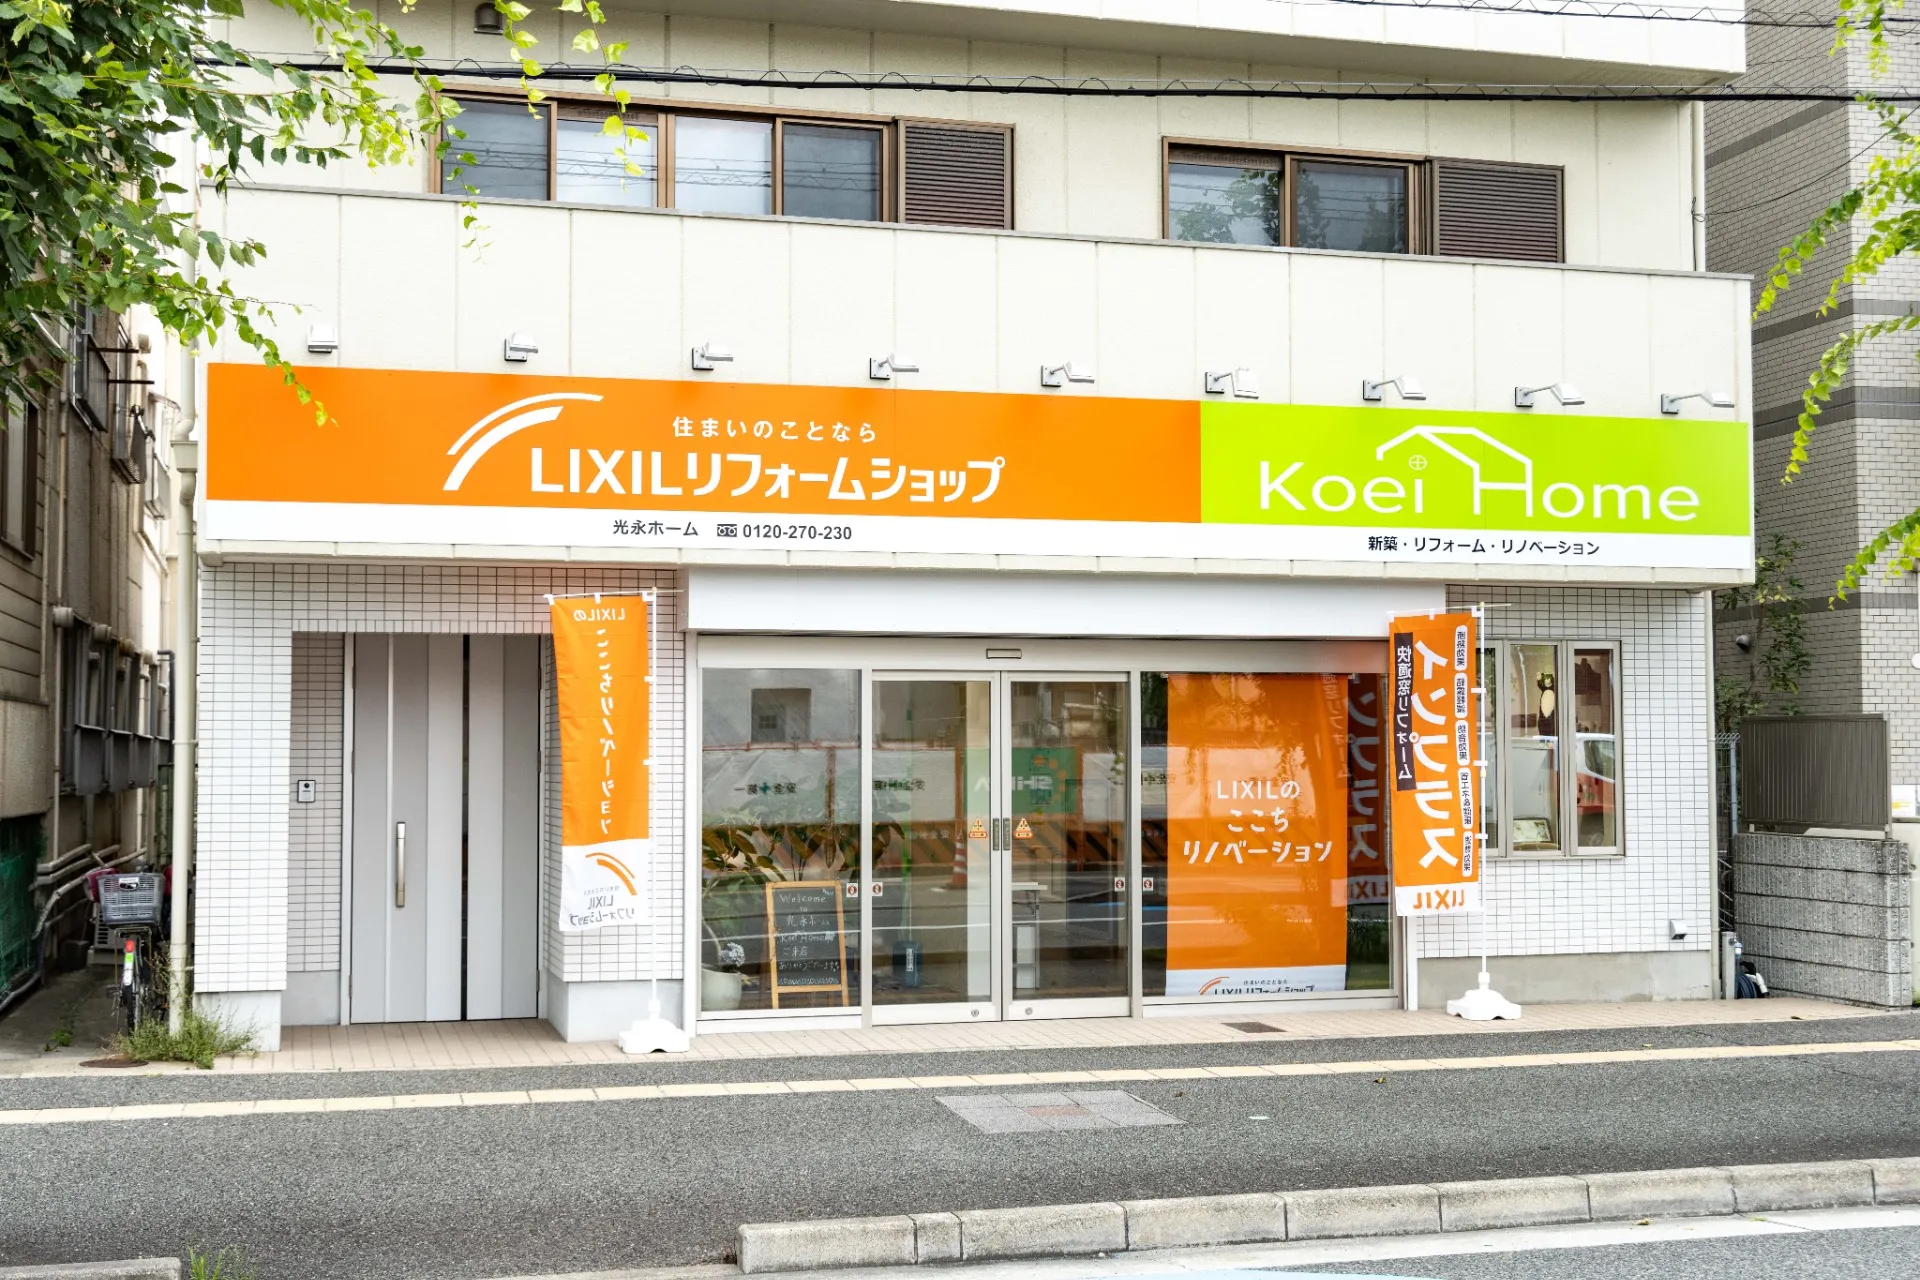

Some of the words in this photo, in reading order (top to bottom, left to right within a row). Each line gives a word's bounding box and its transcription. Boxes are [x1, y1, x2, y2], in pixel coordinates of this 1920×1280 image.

[672, 416, 878, 443] 住まいのことなら
[530, 446, 1006, 504] LIXILリフォームショップ
[1259, 454, 1424, 515] Koei
[1472, 450, 1700, 522] Home
[612, 518, 699, 538] 光永ホーム
[742, 523, 853, 542] 0120-270-230
[1367, 535, 1600, 556] 新築・リフォーム・リノベーション
[1216, 779, 1300, 800] LIXILの
[1227, 807, 1290, 833] ここち
[1183, 840, 1333, 865] リノベーション
[779, 893, 827, 903] Welcome
